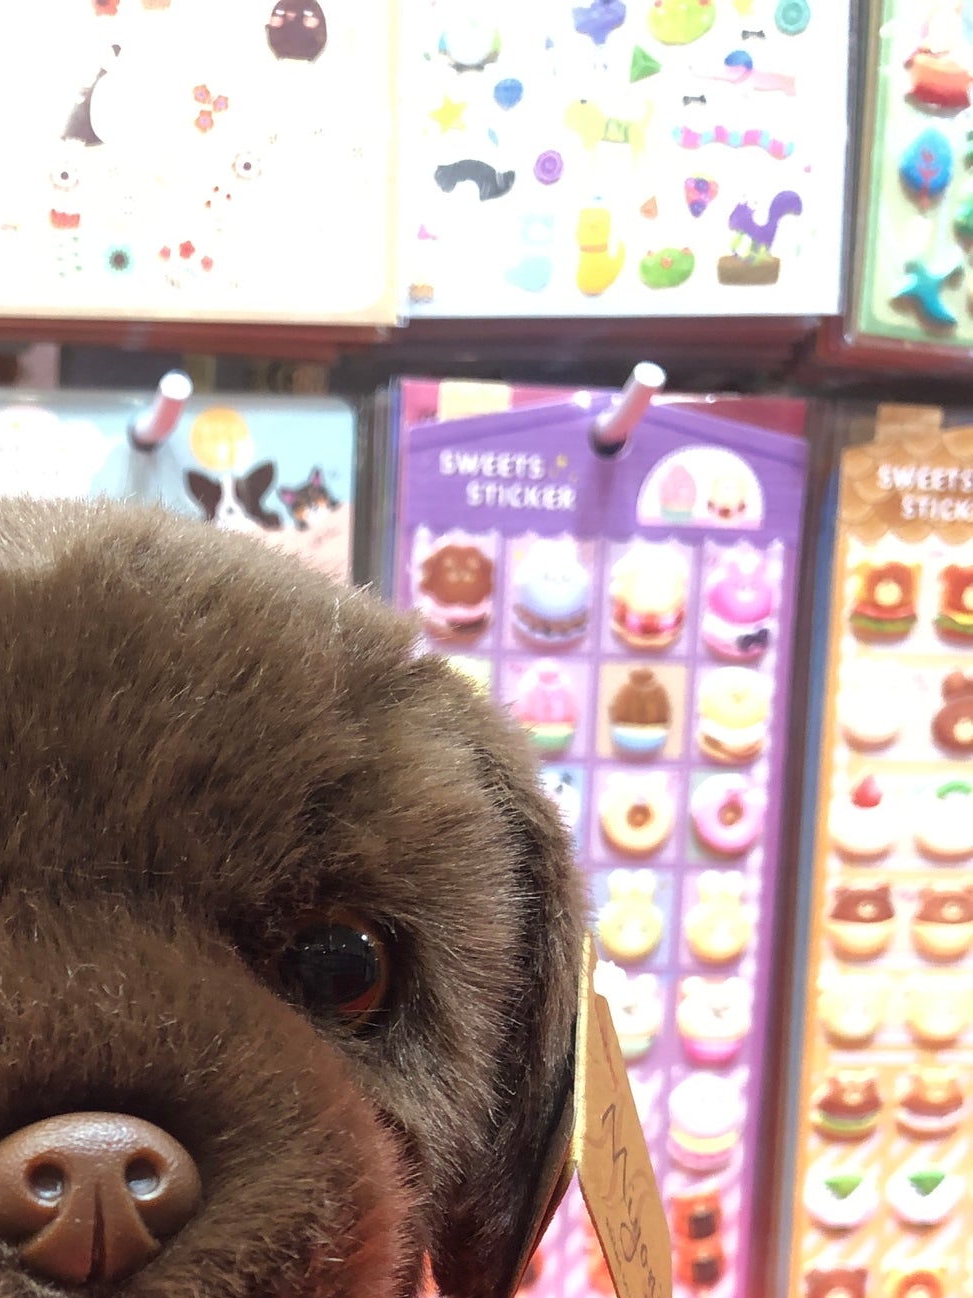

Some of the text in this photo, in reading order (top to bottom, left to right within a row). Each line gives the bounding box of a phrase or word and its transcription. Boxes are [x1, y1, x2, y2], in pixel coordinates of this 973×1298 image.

[439, 449, 545, 481] SWEETS
[876, 463, 973, 493] SWEETS
[466, 478, 577, 512] STICKER
